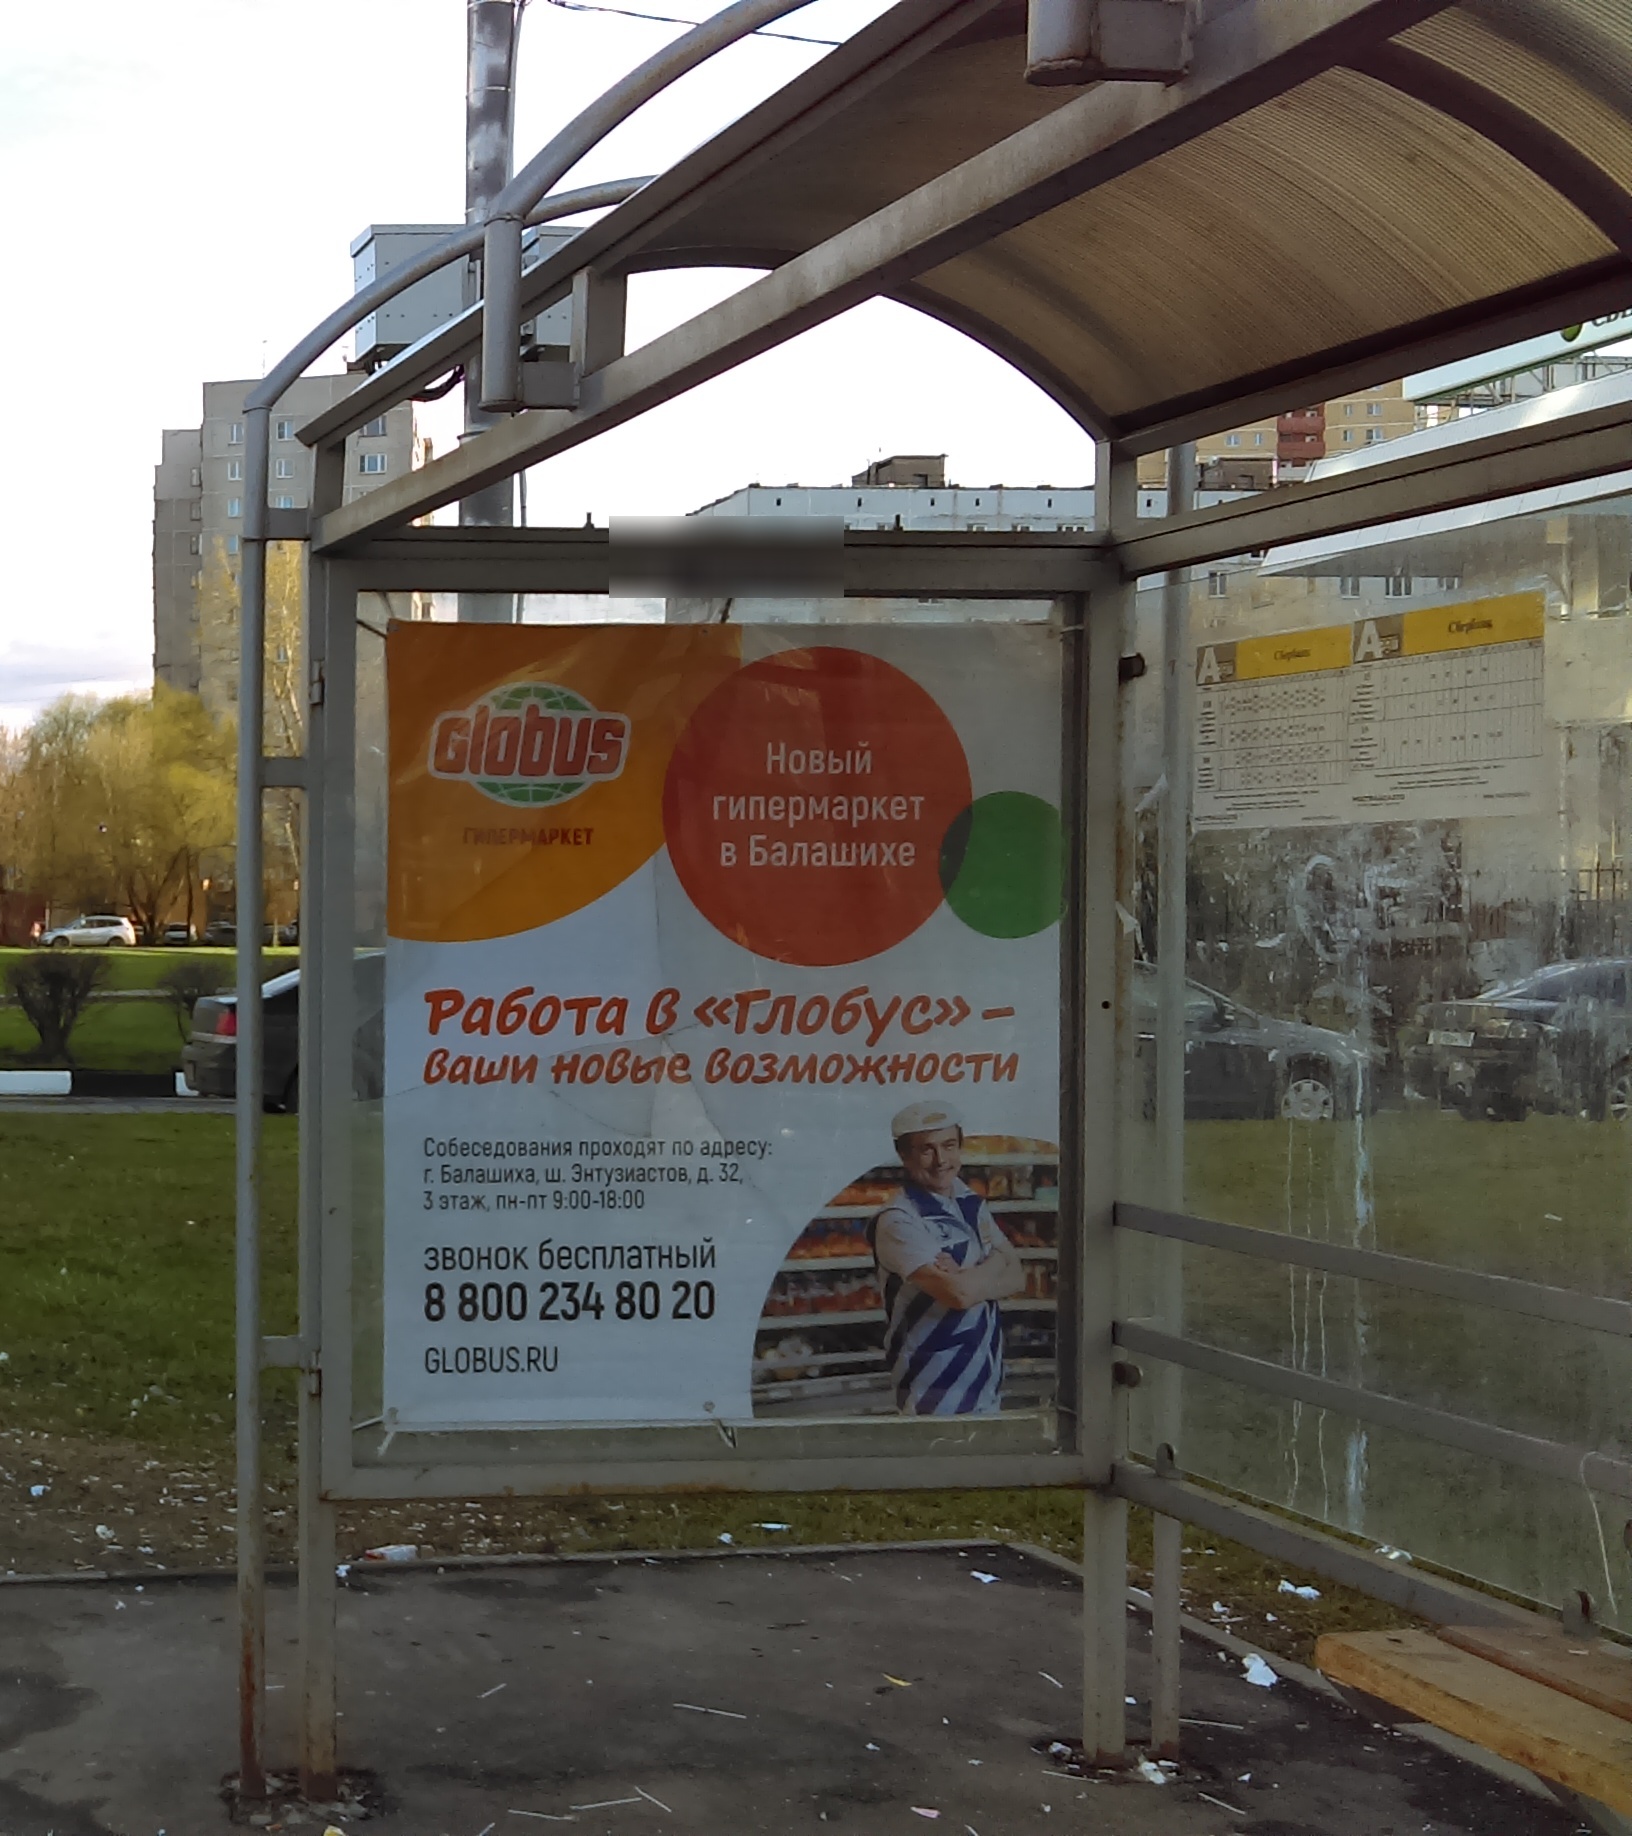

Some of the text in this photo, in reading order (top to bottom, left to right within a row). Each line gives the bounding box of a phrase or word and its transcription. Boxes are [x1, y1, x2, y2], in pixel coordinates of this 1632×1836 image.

[766, 740, 873, 775] Новый
[712, 795, 925, 828] гипермаркет
[462, 827, 595, 846] ГИПЕРМАРКЕТ
[720, 833, 916, 867] в Балашихе
[423, 985, 630, 1037] Работа
[645, 987, 681, 1035] в
[693, 985, 971, 1048] «Глобус»
[423, 1047, 1019, 1086] ваши новые возможности
[423, 1137, 773, 1160] Собеседования проходят по адресу:
[423, 1162, 744, 1187] г. Балашиха, ш. Энтузиастов, д. 32,
[423, 1190, 646, 1213] 3 этаж, пн-пт 9:00-18:00
[538, 1237, 717, 1270] бесплатный
[424, 1280, 715, 1322] 8 800 234 80 20
[424, 1346, 559, 1374] GLOBUS.RU
